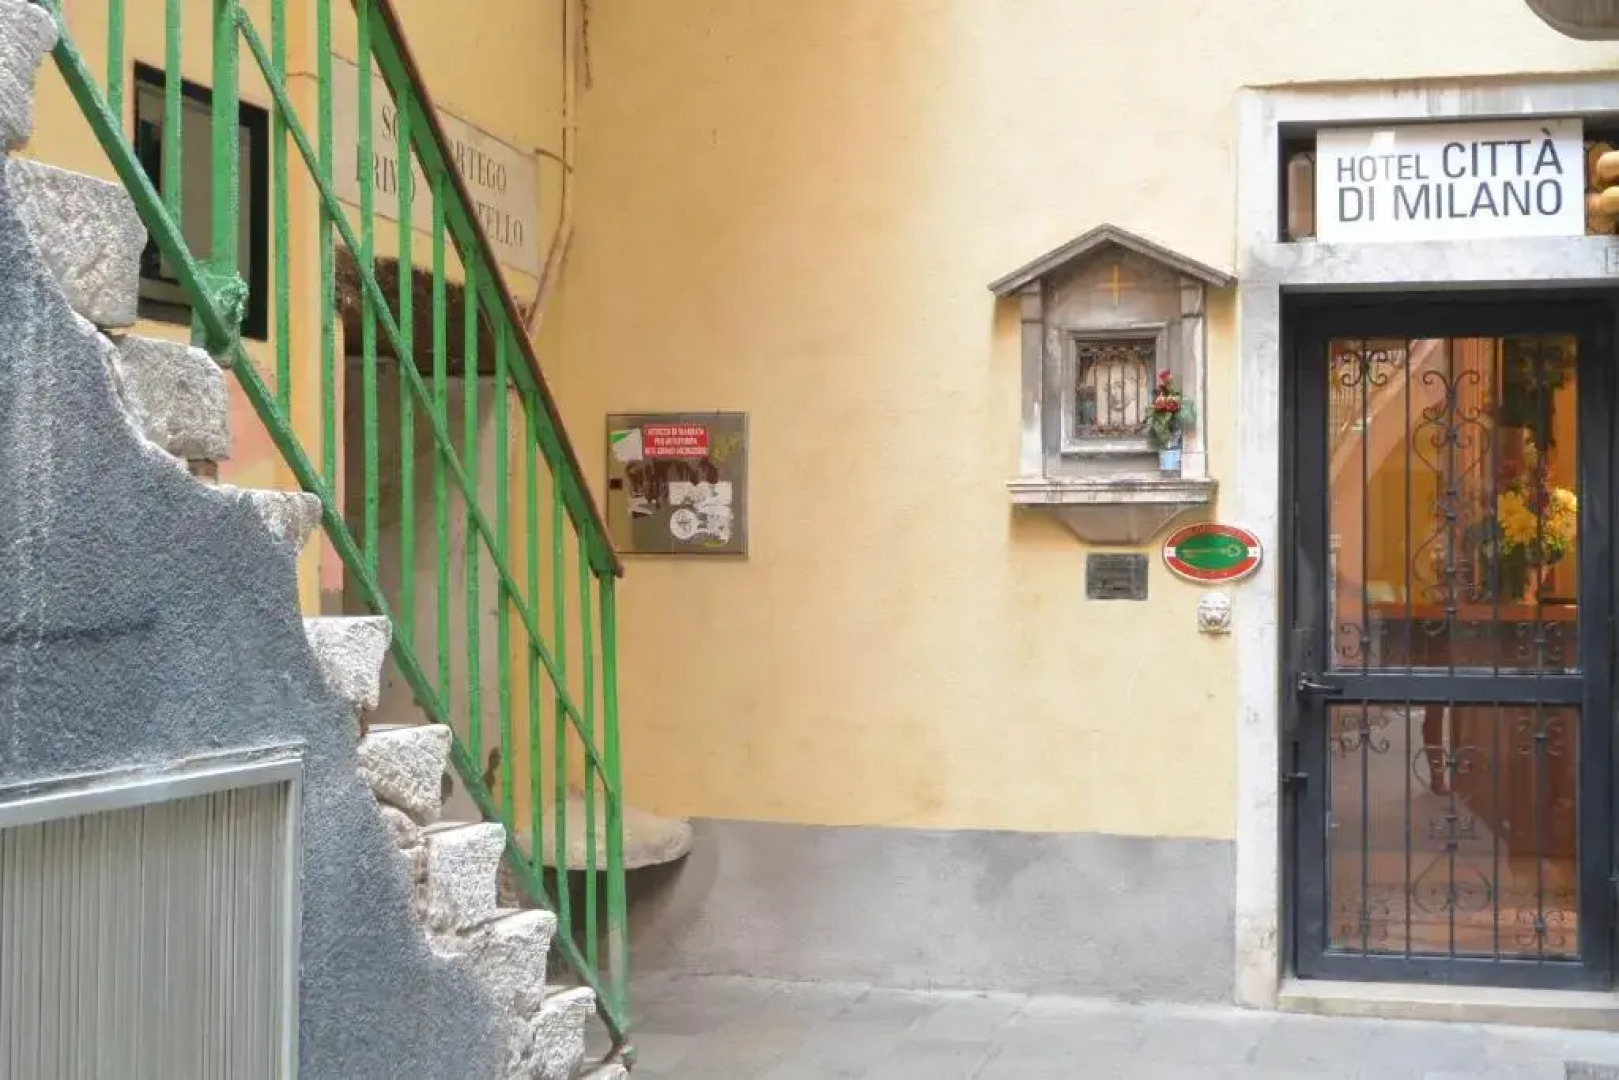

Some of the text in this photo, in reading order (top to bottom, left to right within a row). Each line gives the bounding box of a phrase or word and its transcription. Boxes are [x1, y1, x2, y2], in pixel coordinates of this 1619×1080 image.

[1337, 127, 1563, 182] HOTEL CITTÀ
[1339, 179, 1562, 222] DI MILANO
